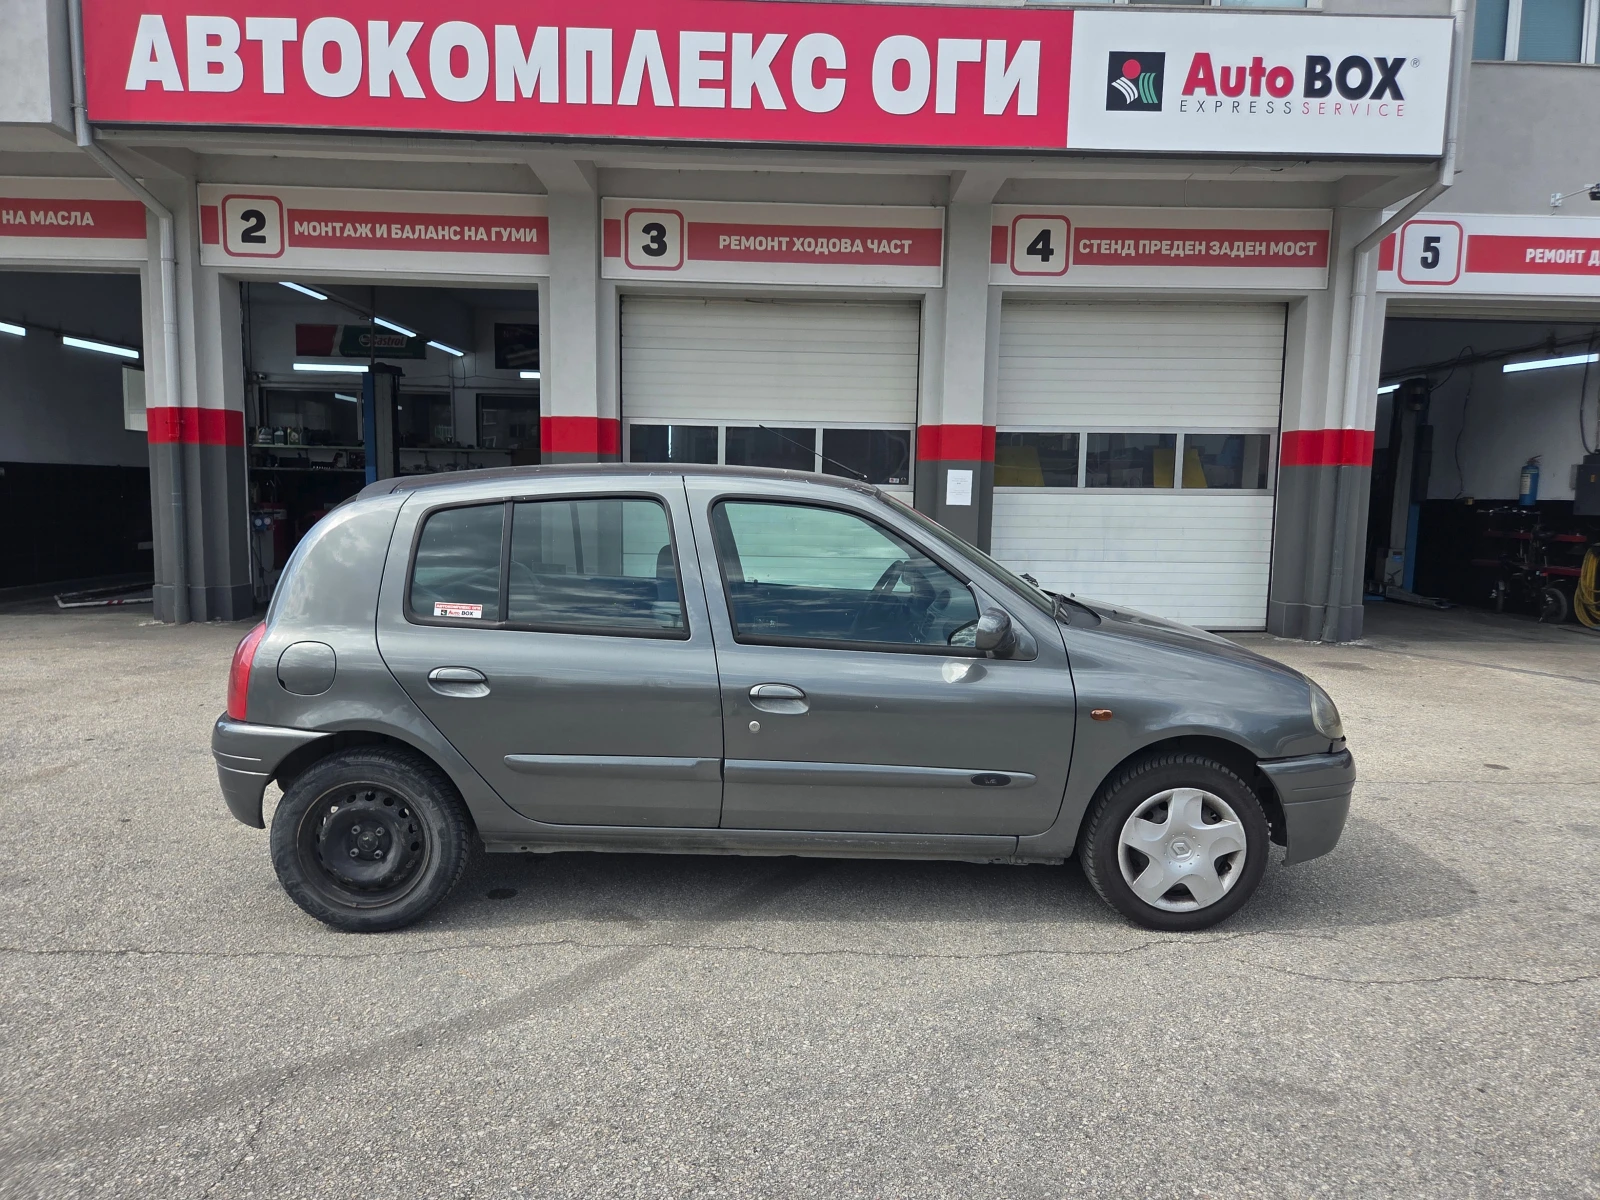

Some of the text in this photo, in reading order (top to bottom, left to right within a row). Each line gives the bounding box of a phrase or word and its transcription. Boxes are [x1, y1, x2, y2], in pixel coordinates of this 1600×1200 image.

[125, 14, 1040, 115] АВТОКОМПЛЕКС ОГИ
[1181, 52, 1294, 98] Auto
[2, 210, 94, 226] НА МАСЛА
[240, 209, 267, 244] 2
[294, 221, 538, 243] МОНТАЖ И БАЛАНС НА ГУМИ
[641, 222, 668, 257] 3
[719, 235, 913, 255] РЕМОНТ ХОДОВА ЧАСТ
[1026, 229, 1055, 263] 4
[1079, 239, 1317, 258] СТЕНД ПРЕДЕН ЗАДЕН МОСТ
[1420, 236, 1441, 270] 5
[1525, 248, 1586, 264] РЕМОНТ
